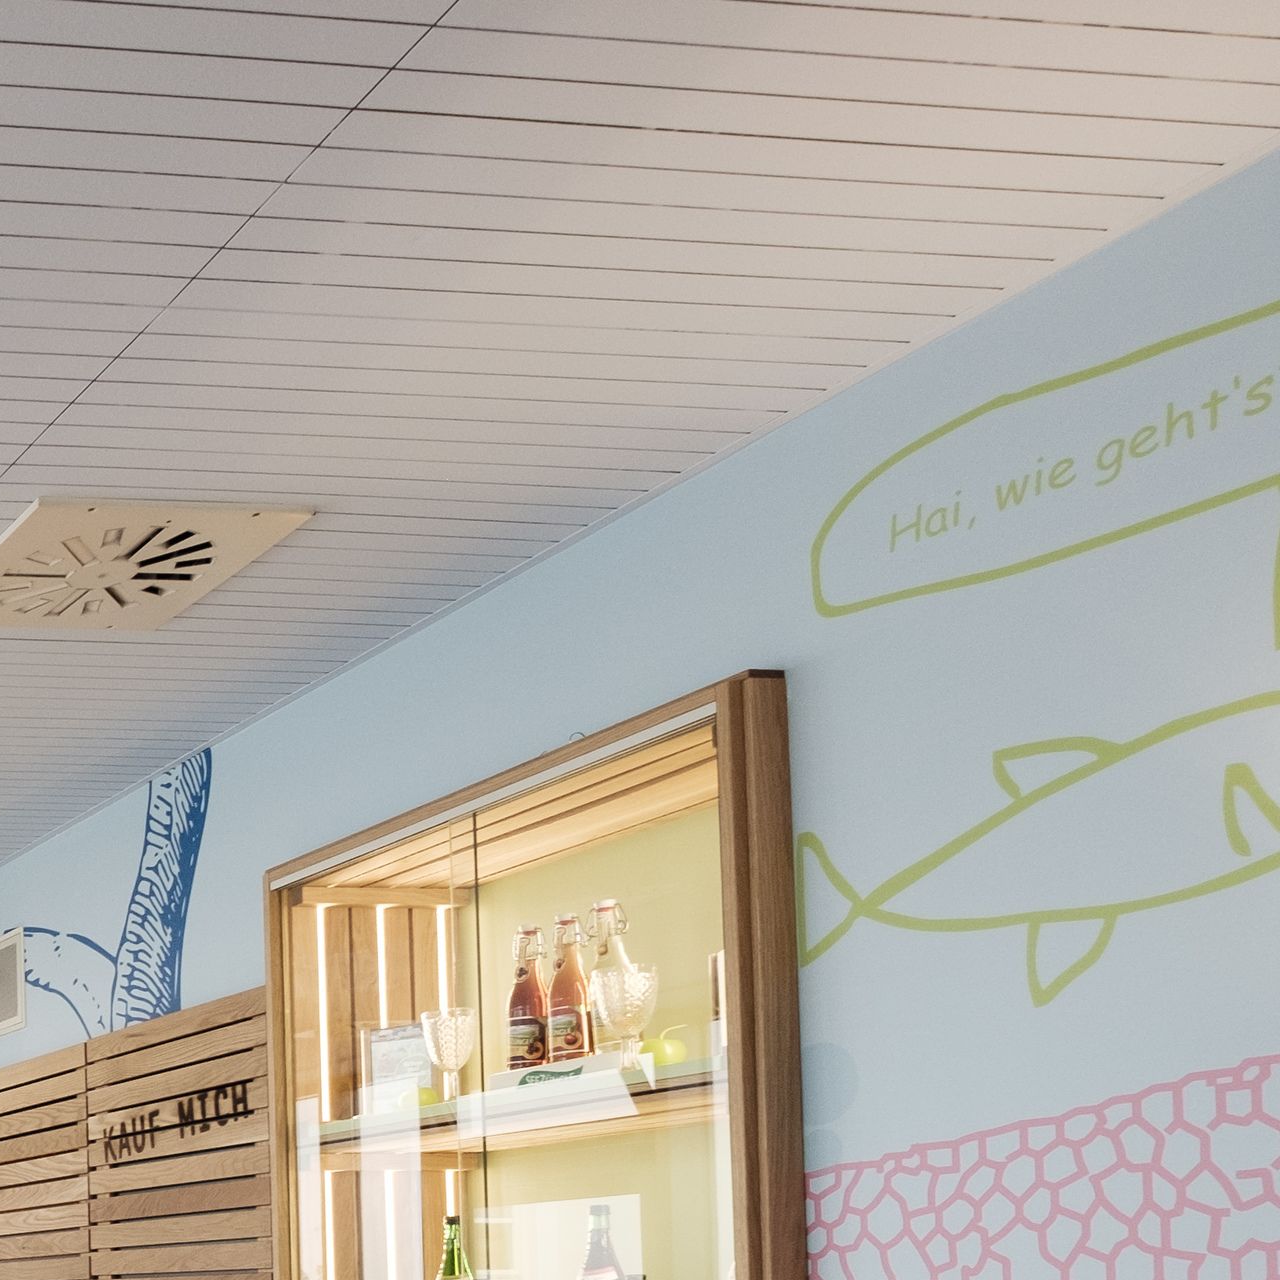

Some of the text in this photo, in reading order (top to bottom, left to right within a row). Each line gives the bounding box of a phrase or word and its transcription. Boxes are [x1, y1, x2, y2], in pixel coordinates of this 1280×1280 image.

[890, 373, 1275, 552] Hai, wie geht's
[103, 1082, 249, 1163] KAUF MICH
